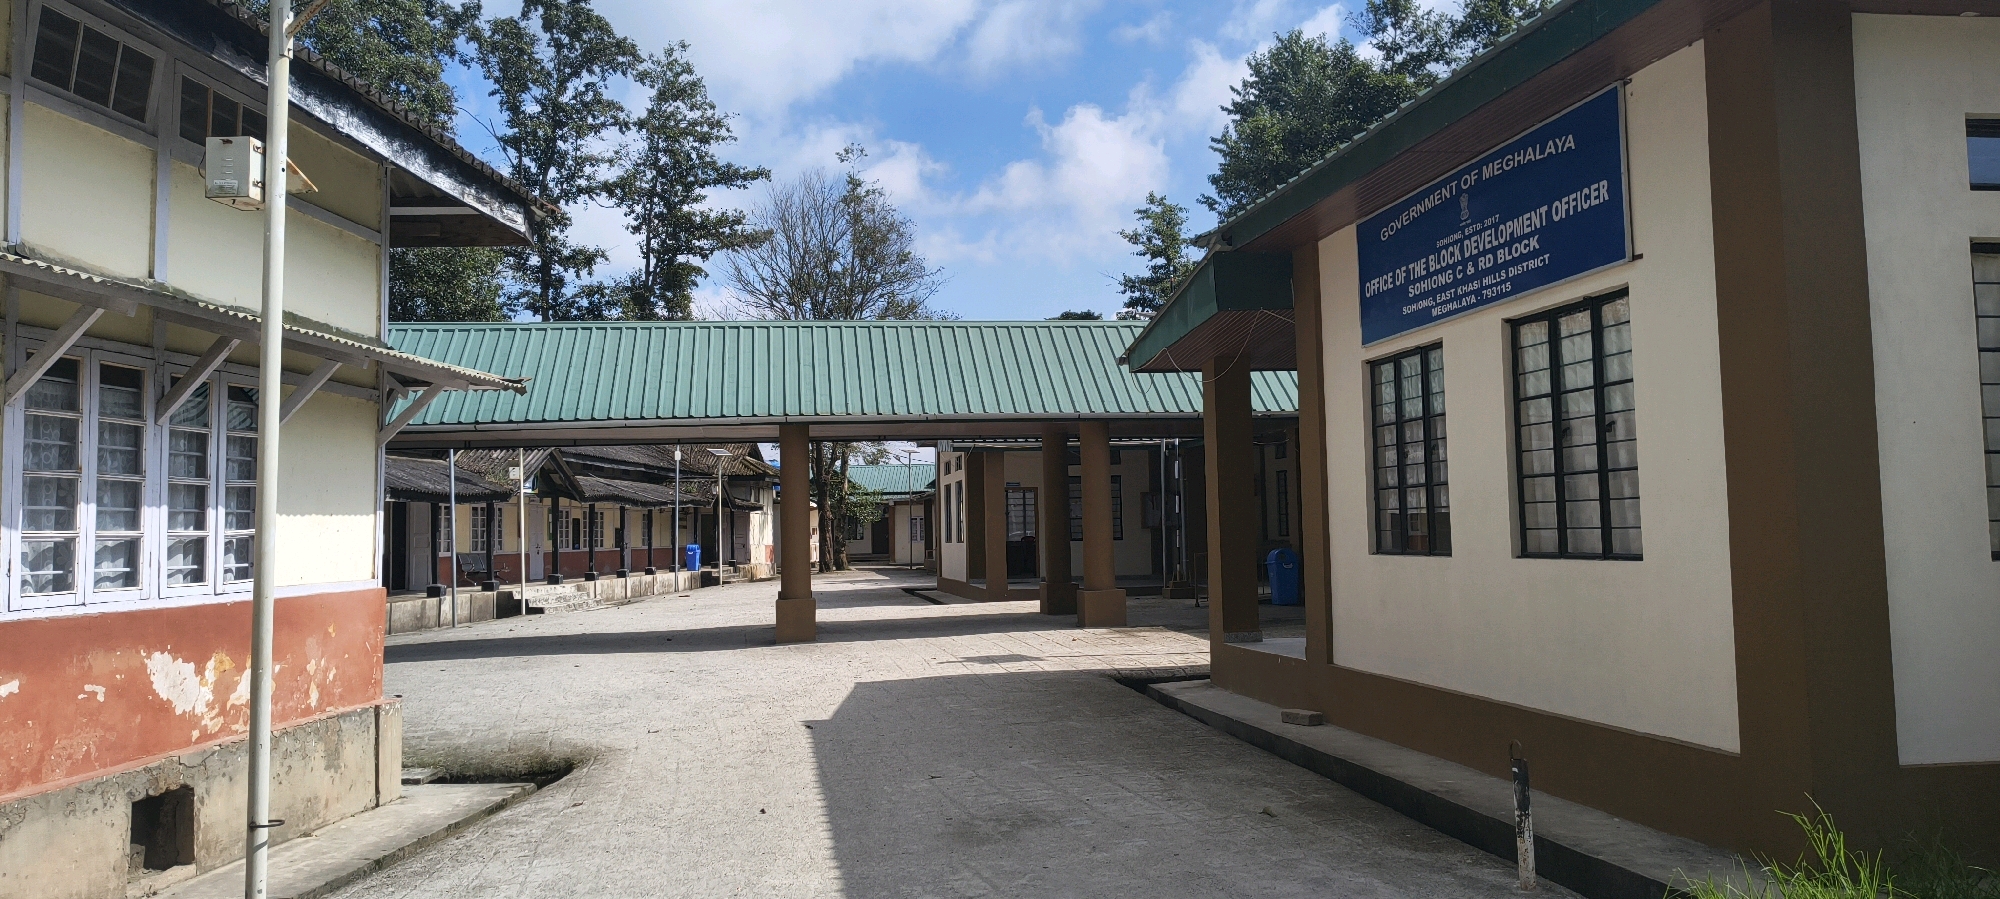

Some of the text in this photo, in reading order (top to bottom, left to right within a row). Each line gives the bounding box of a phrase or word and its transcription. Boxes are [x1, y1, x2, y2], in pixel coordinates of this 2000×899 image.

[1380, 134, 1575, 241] GOVERNMENT OF MEGHALAYA
[1365, 180, 1609, 298] OFFICE OF THE BLOCK DEVELOPMENT OFFICER
[1436, 231, 1463, 248] SOHIONG,
[1484, 214, 1499, 227] 2017
[1402, 254, 1550, 315] SOHIONG, EAST KHASI HILLS DISTRICT
[1409, 235, 1539, 297] SOHIONG C & RD BLOCK
[1432, 294, 1476, 317] MEGHALAYA
[1482, 282, 1512, 300] 793115
